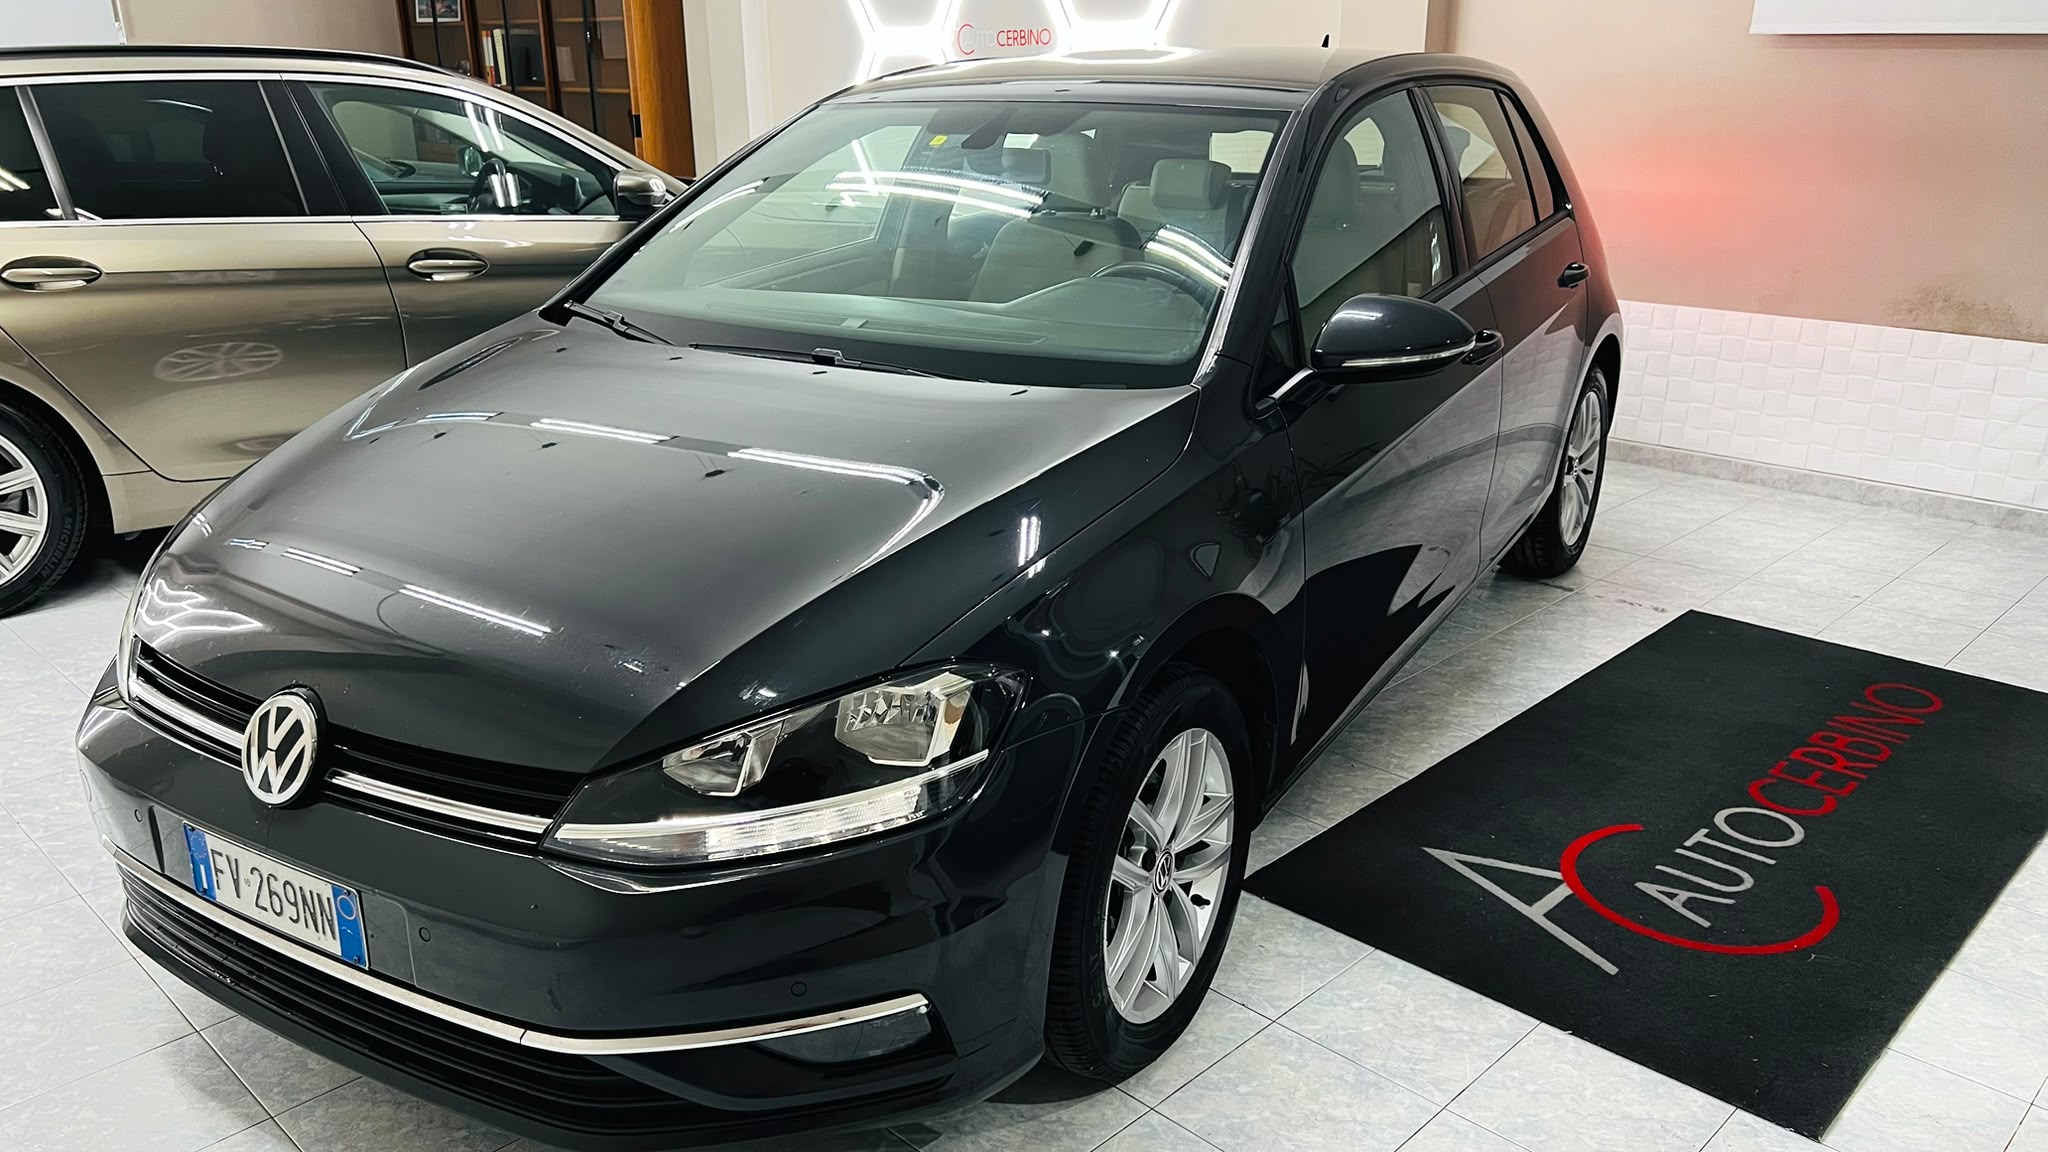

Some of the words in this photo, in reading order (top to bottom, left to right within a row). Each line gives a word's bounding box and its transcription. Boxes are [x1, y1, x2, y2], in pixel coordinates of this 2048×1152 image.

[41, 515, 73, 577] MICHELIN
[247, 699, 313, 800] VW
[1635, 683, 1944, 927] AUTOCERBINO
